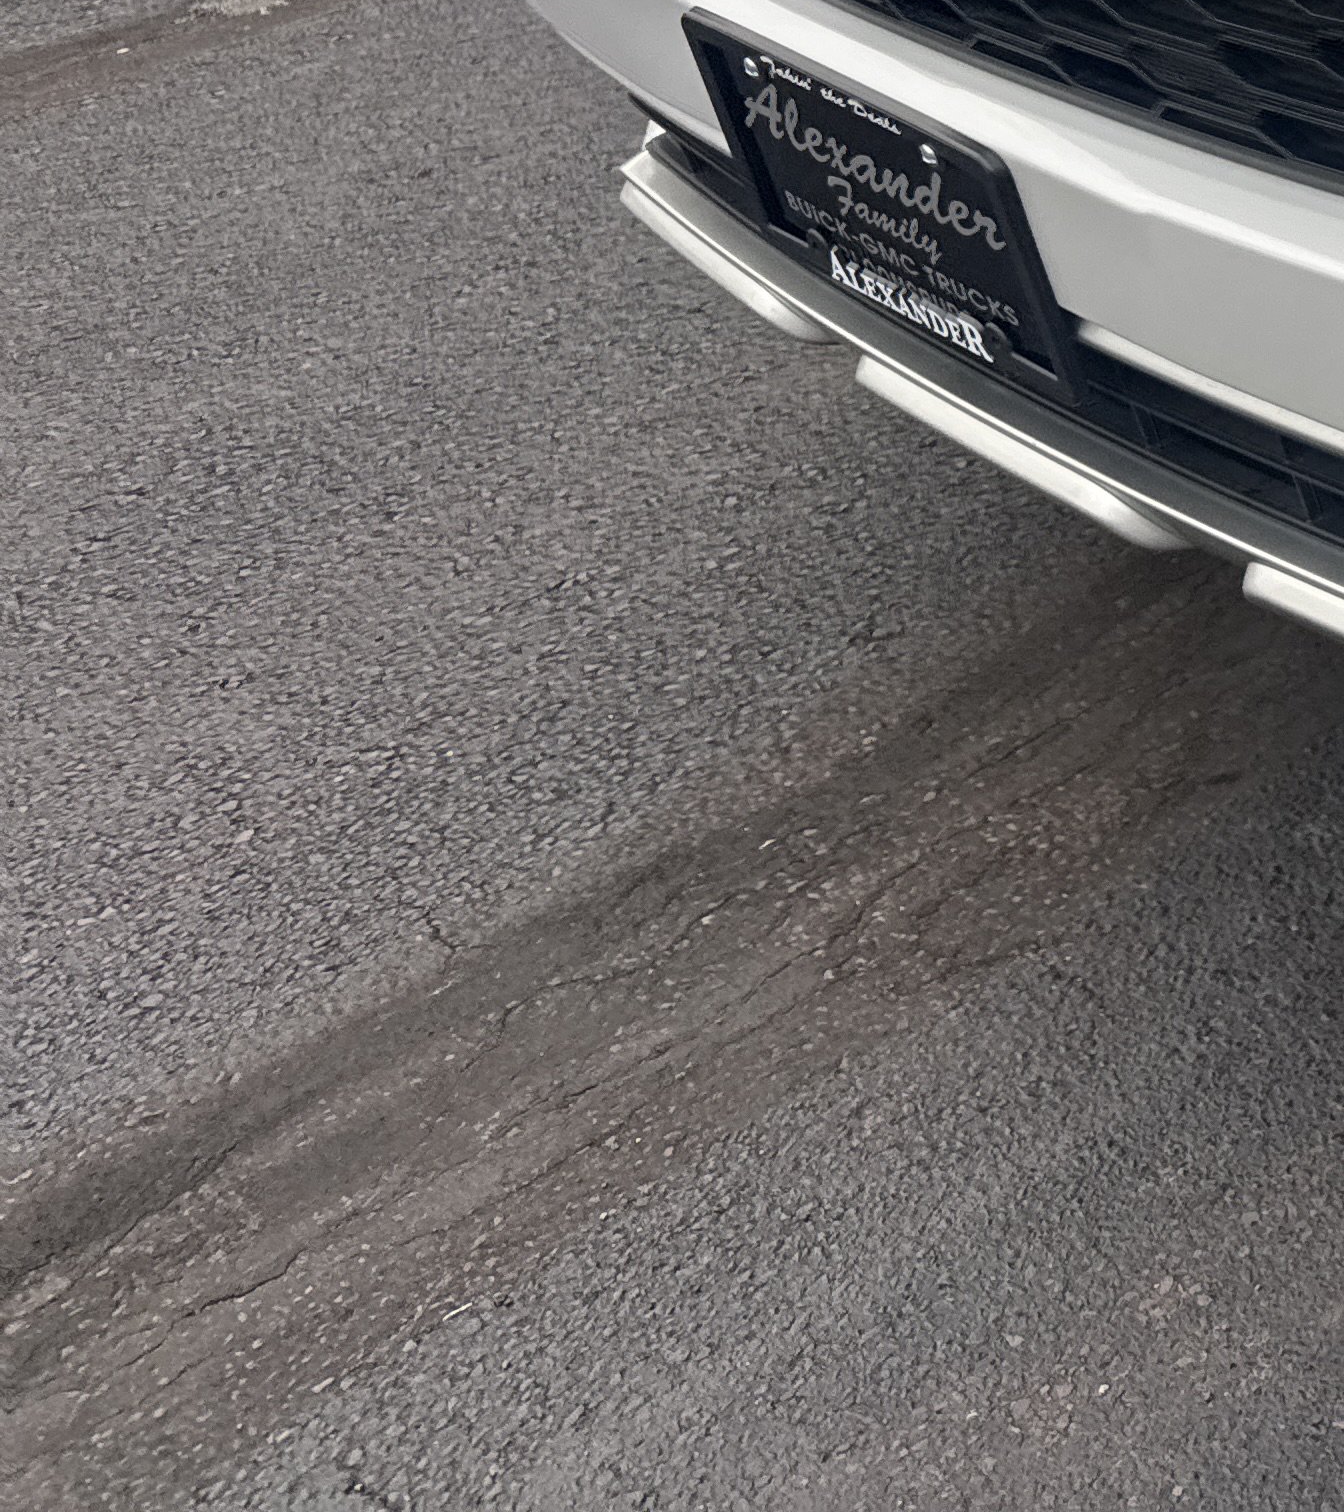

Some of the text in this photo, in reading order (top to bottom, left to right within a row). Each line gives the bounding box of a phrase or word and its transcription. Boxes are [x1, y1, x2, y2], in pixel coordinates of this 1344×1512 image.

[744, 83, 1006, 250] Alexander
[828, 175, 943, 265] Family
[831, 245, 994, 364] ALEXANDER
[924, 264, 1019, 326] TRUCKS
